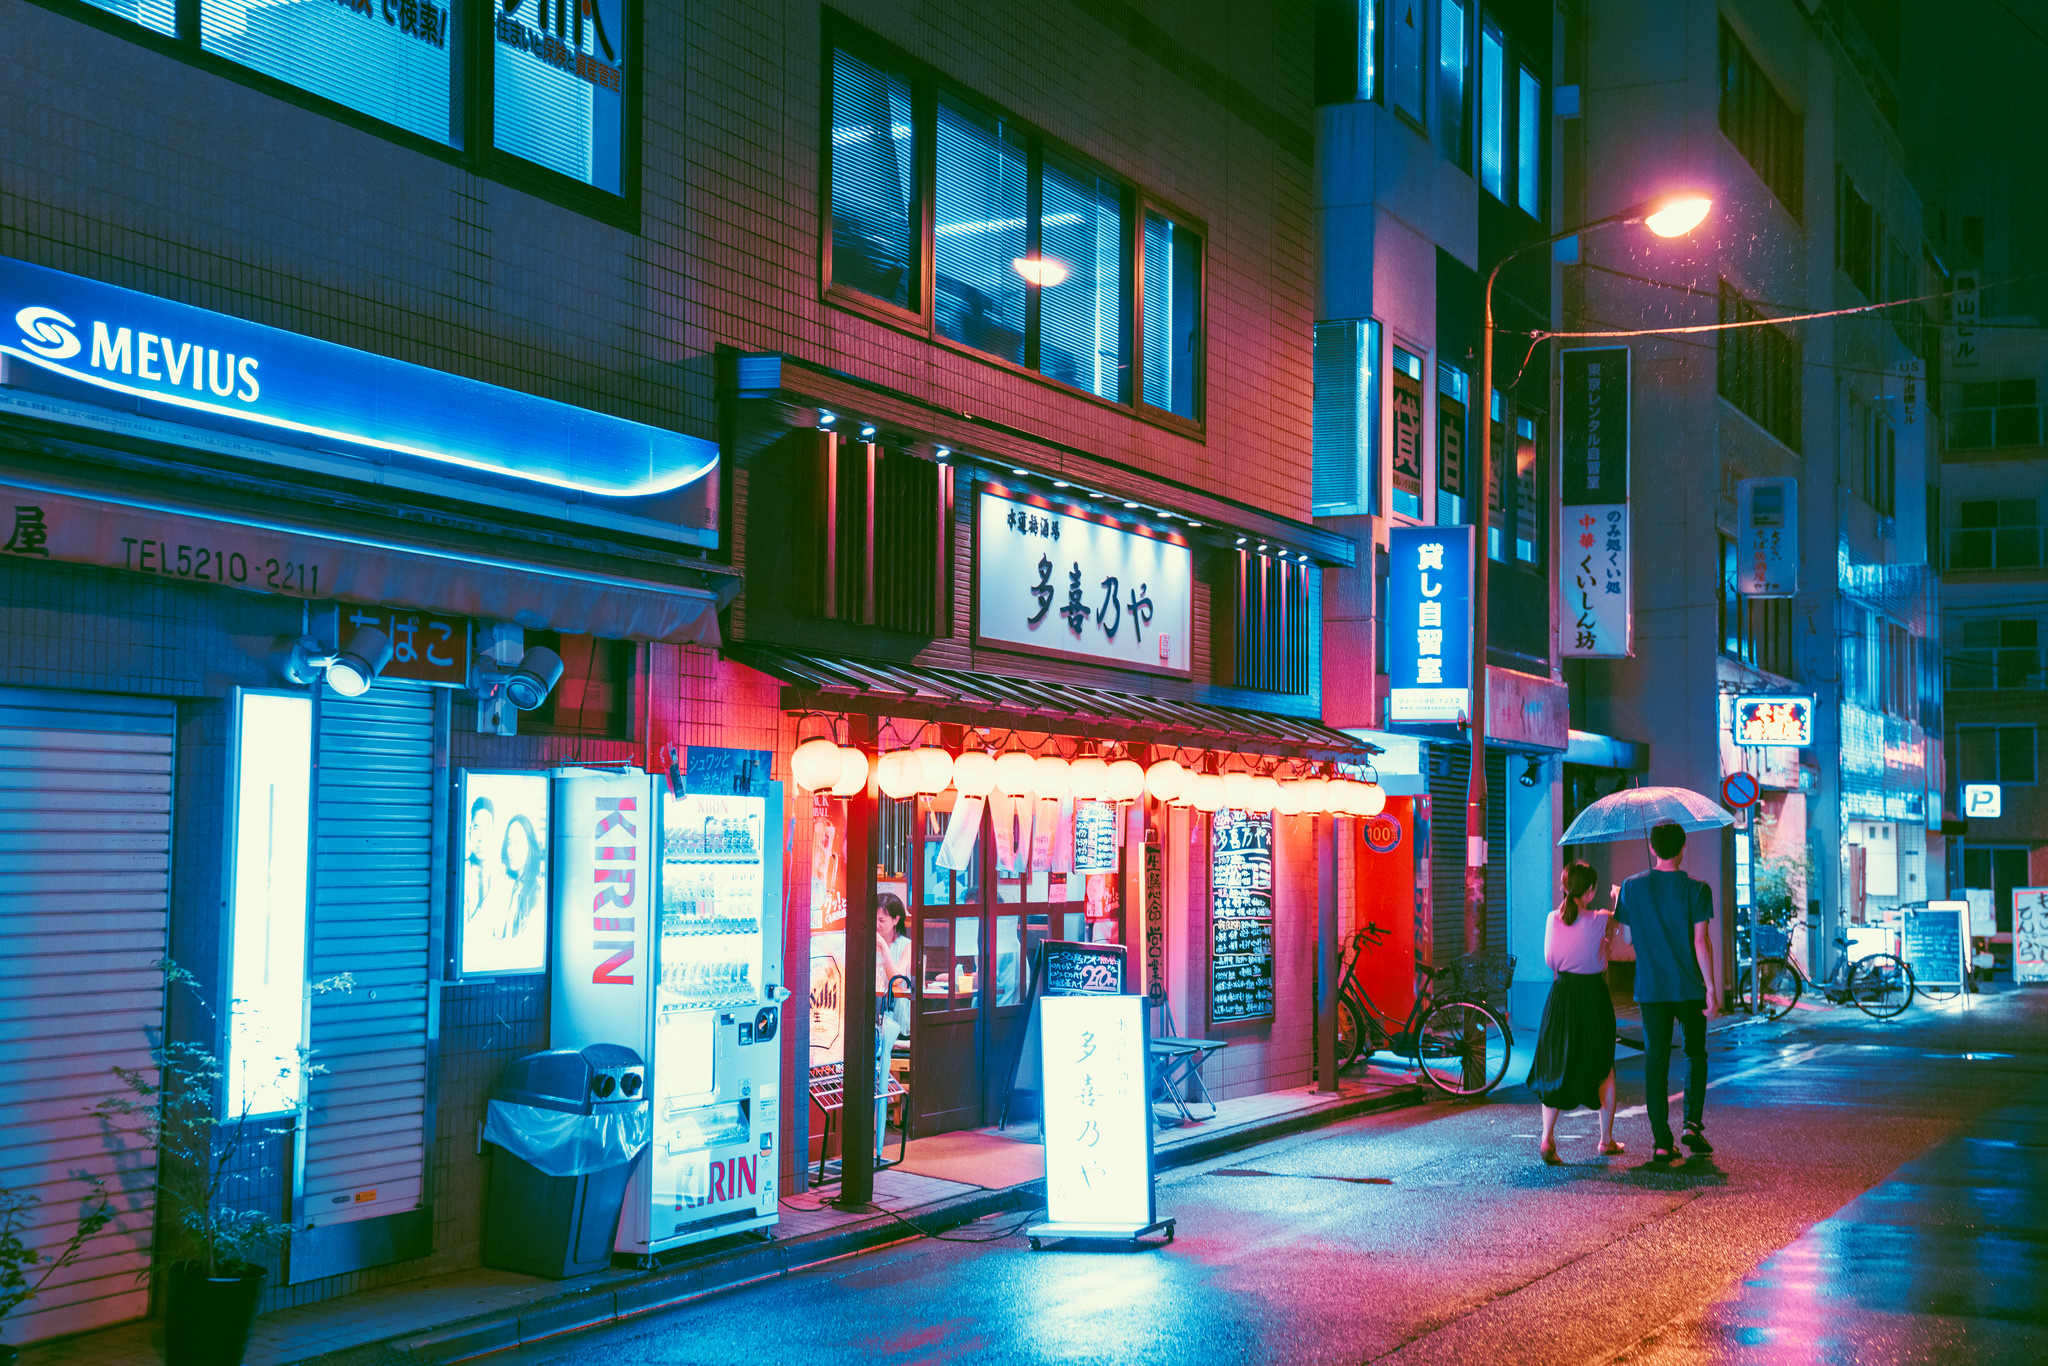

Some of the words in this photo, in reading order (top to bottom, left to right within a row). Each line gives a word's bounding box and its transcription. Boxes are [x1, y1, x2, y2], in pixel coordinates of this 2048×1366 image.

[90, 320, 260, 403] MEVIUS
[1443, 417, 1461, 494] 自
[1586, 362, 1601, 490] 東京レンタル自習室
[3, 505, 51, 558] 屋
[1605, 510, 1623, 595] のみ処くい処
[1416, 543, 1444, 684] 貸し自習室
[688, 751, 732, 773] シュワッと
[697, 798, 729, 815] KIRIN
[1971, 790, 1995, 812] P
[592, 796, 637, 987] KIRIN
[1146, 846, 1163, 1004] 一生懸命営業中
[2016, 906, 2040, 964] てんぷら
[809, 980, 838, 1012] sahi
[1074, 1029, 1106, 1190] 多喜乃や
[674, 1153, 758, 1213] KIRIN
